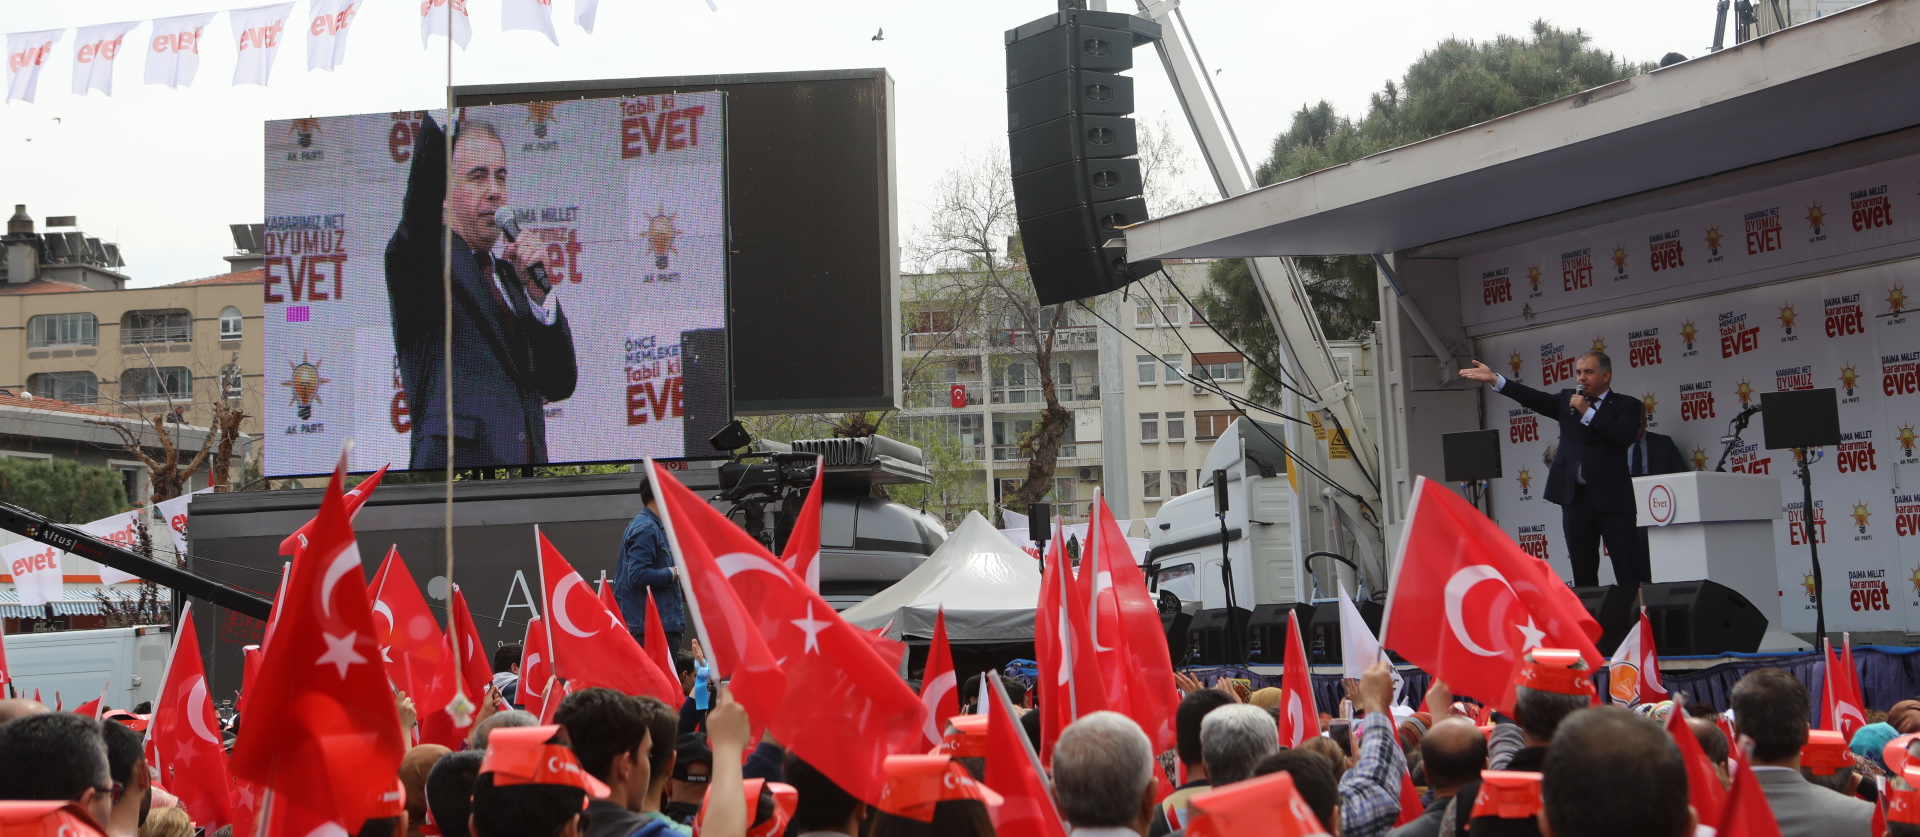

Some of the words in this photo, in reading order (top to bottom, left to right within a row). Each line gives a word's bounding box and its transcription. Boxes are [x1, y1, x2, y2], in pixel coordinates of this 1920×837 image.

[622, 105, 705, 160] EVET
[1745, 215, 1780, 232] OYUMUZ
[1852, 196, 1893, 232] evet
[264, 230, 345, 255] OYUMUZ
[1746, 226, 1782, 255] EVET
[1562, 255, 1591, 271] OYUMUZ
[1651, 240, 1684, 272] evet
[264, 253, 348, 303] EVET
[1483, 277, 1512, 306] evet
[1563, 266, 1593, 292] EVET
[1825, 305, 1864, 338] evet
[1629, 338, 1662, 368] evet
[1720, 326, 1760, 359] EVET
[1542, 357, 1575, 386] EVET
[1777, 373, 1812, 389] OYUMUZ
[627, 376, 684, 427] EVE
[1681, 391, 1715, 421] evet
[1510, 417, 1539, 444] evet
[1837, 441, 1877, 473] evet
[1653, 498, 1668, 508] Evet
[43, 530, 72, 547] Altus
[12, 546, 57, 576] evet
[1850, 580, 1890, 611] evet
